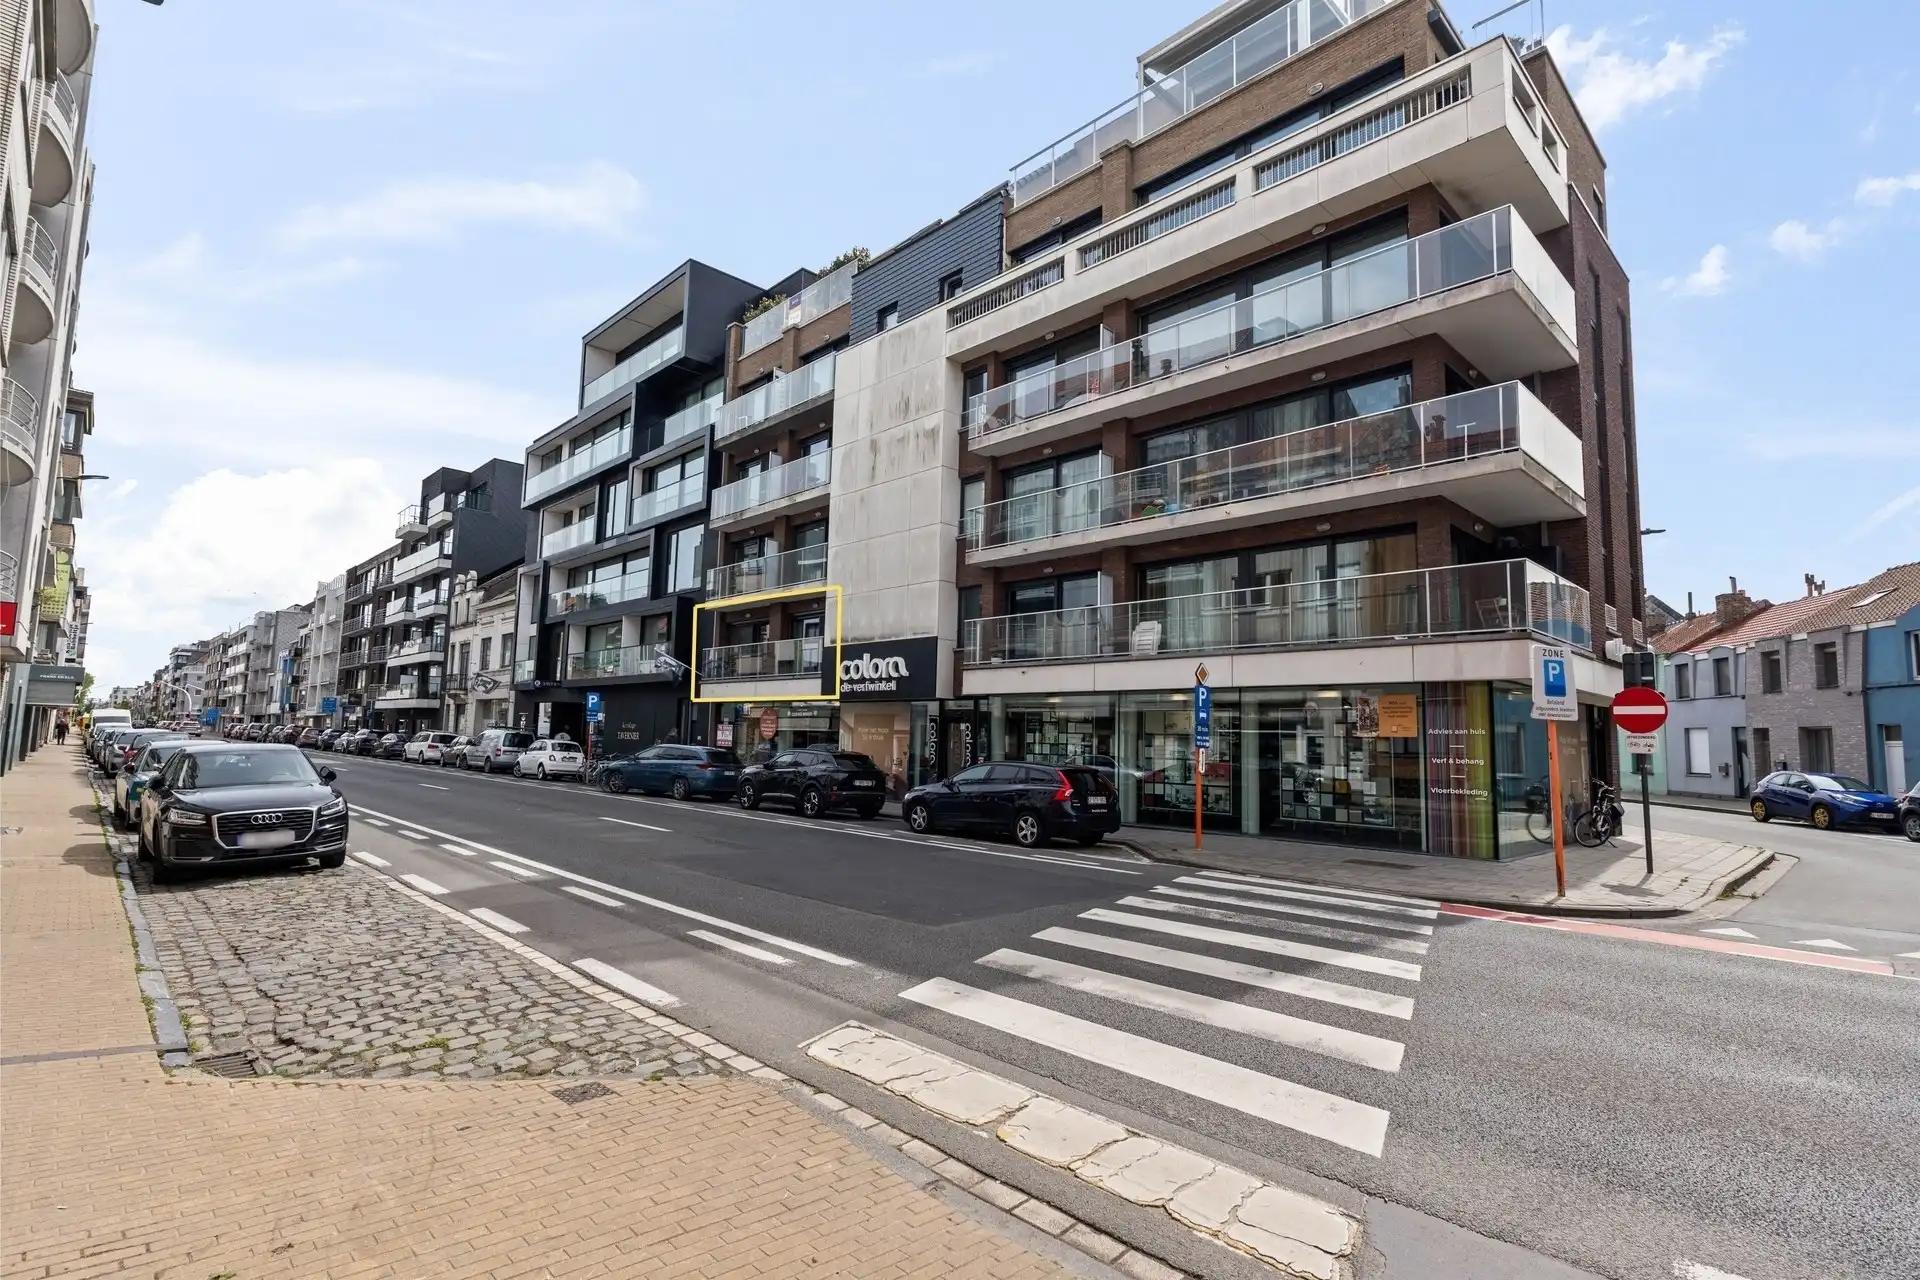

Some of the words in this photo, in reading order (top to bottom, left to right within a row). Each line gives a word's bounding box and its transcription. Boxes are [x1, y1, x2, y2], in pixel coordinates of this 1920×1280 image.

[1542, 648, 1564, 658] ZONE
[840, 653, 909, 680] colora
[1548, 662, 1560, 682] P
[840, 682, 852, 692] de
[589, 695, 598, 708] P
[1199, 687, 1207, 706] P
[930, 722, 938, 766] colora
[1455, 757, 1484, 765] behang
[1430, 787, 1488, 797] Vloerbekleding
